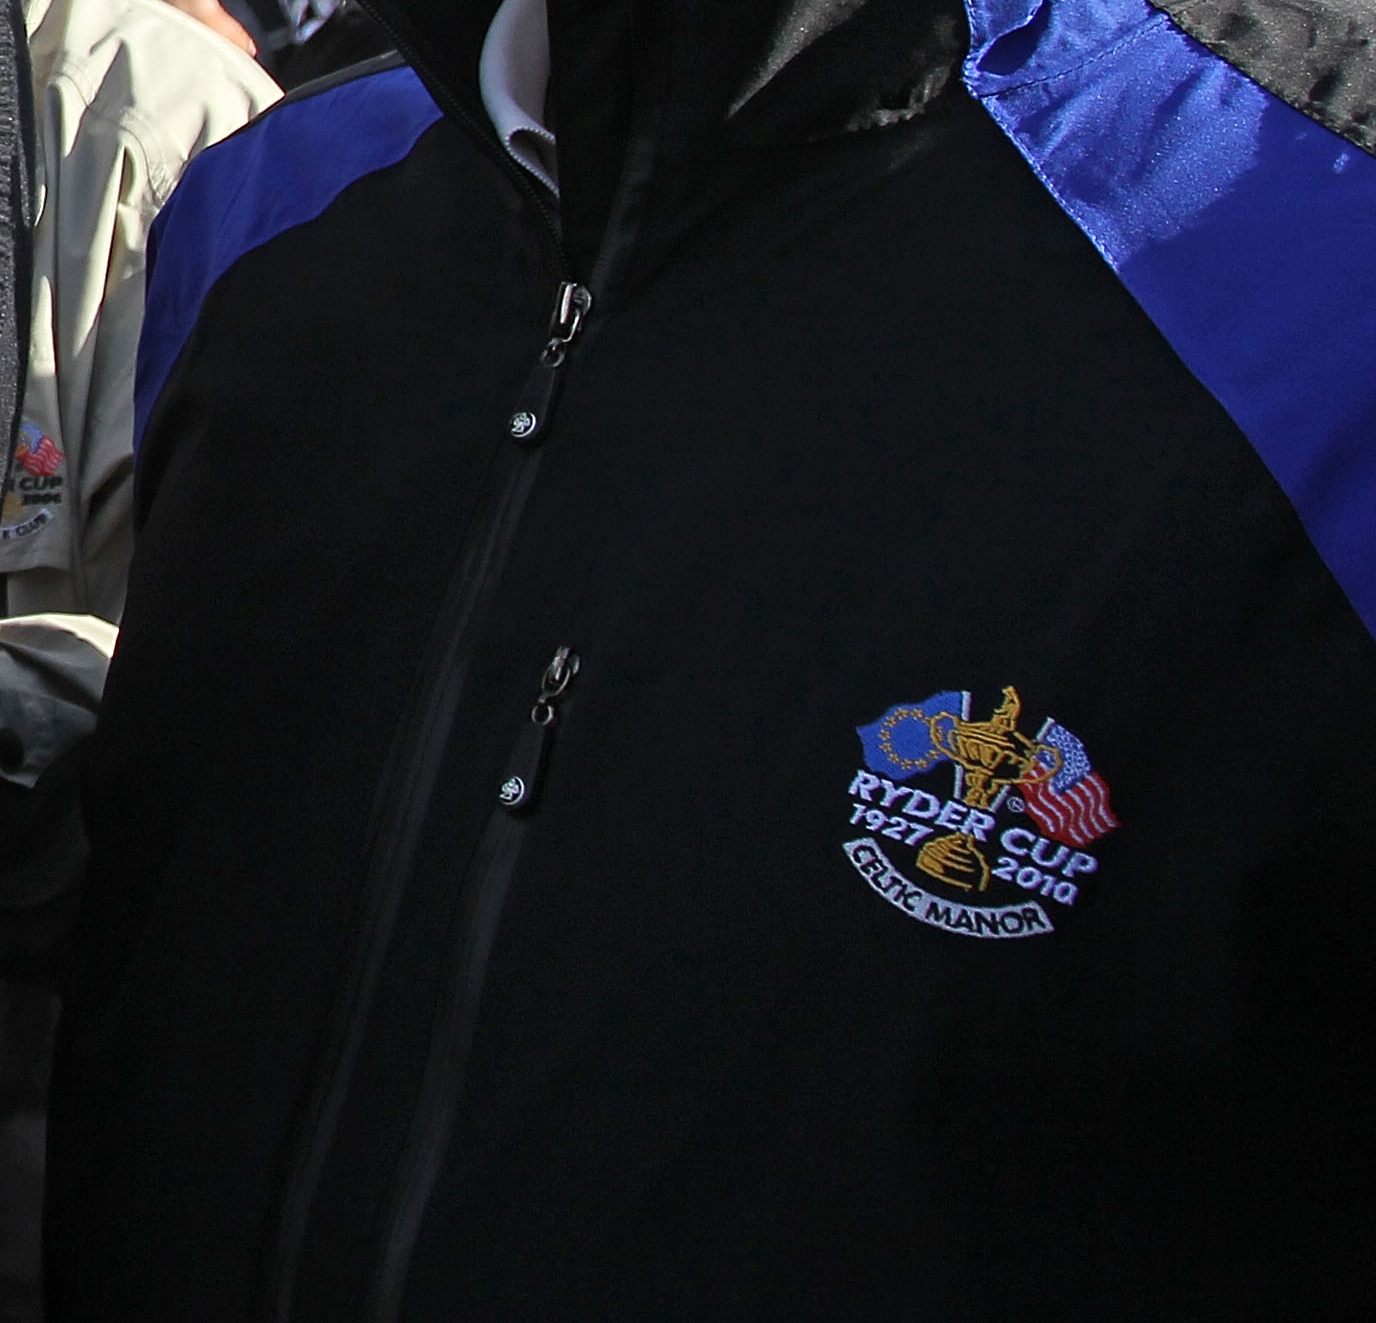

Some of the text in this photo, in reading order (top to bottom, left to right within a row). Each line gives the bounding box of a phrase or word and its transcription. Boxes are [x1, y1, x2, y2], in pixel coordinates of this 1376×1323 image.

[848, 769, 1100, 878] RYDER CUP
[849, 803, 935, 847] 1927
[851, 843, 1048, 937] CELTIC MANOR
[991, 856, 1079, 906] 2010
